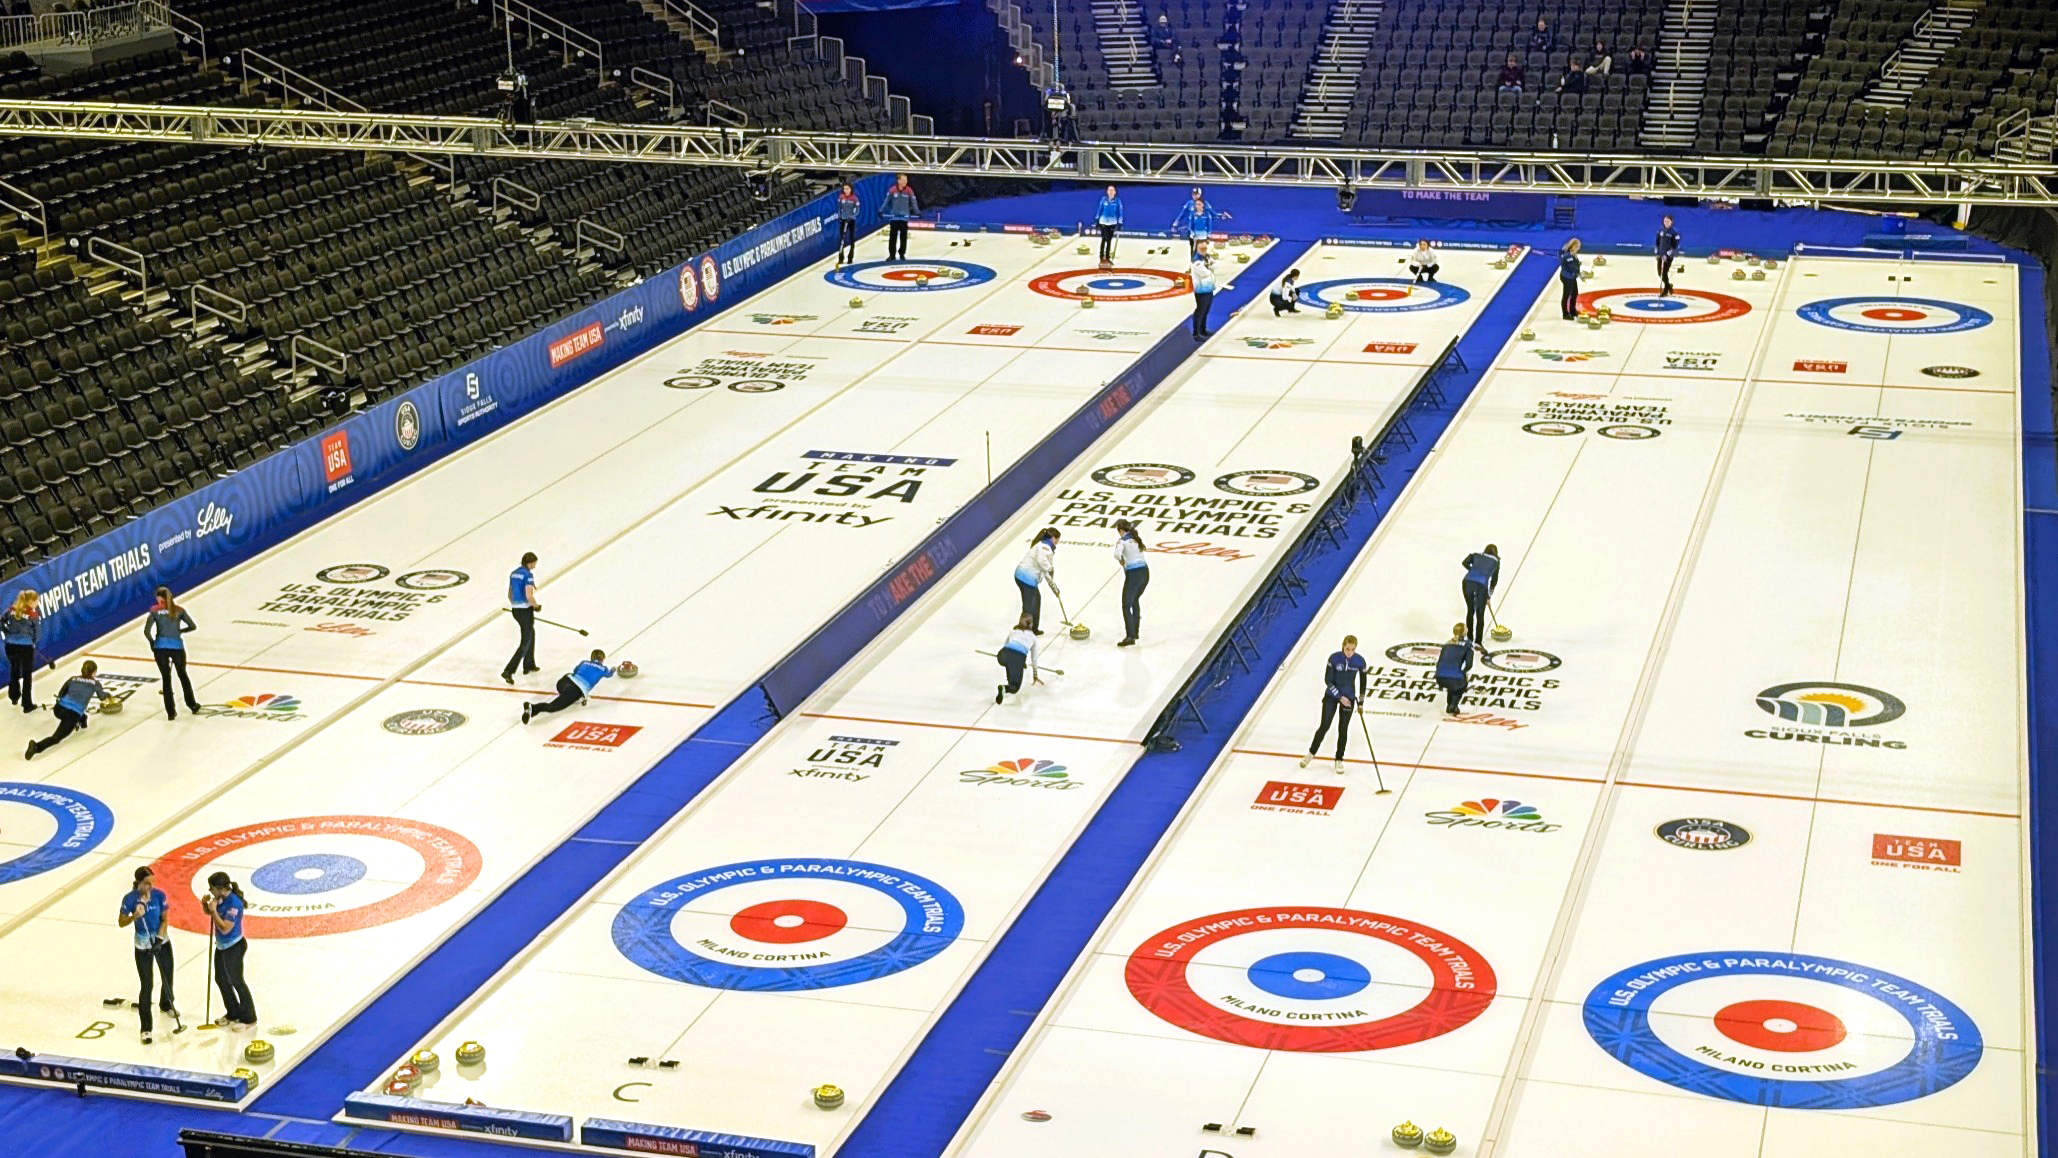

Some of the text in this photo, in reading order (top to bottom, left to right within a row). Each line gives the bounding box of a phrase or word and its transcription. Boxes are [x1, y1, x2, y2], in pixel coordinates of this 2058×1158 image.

[1402, 190, 1490, 201] TO MAKE THE TEAM
[734, 249, 755, 275] OLYMPIC
[760, 231, 792, 259] PARALYMPIC
[792, 224, 805, 245] TEAM
[805, 216, 822, 240] TRIALS
[618, 305, 644, 331] xfinity
[551, 339, 574, 364] MAKING
[573, 331, 590, 353] TEAM
[589, 326, 602, 346] USA
[695, 364, 806, 375] PARALYMPIC
[701, 358, 764, 367] TRIALS
[695, 369, 769, 379] OLYMPIC
[400, 405, 411, 415] USA
[457, 402, 498, 427] SPORTS AUTHORITY
[460, 395, 493, 416] SIOUX FALLS
[1538, 401, 1669, 413] TEAM TRIALS
[1538, 407, 1664, 419] PARALYMPIC
[1542, 412, 1629, 424] OLYMPIC
[1639, 416, 1673, 426] U.S.
[327, 440, 343, 452] TEAM
[327, 451, 347, 473] USA
[820, 452, 939, 465] MAKING
[807, 461, 927, 477] TEAM
[328, 475, 354, 494] ONE FOR ALL
[752, 472, 923, 504] USA
[762, 498, 848, 507] presented
[1056, 489, 1312, 514] U.S. OLYMPIC &
[706, 505, 895, 528] xfinity
[1062, 502, 1284, 526] PARALYMPIC
[1154, 520, 1280, 539] TRIALS
[75, 501, 234, 599] TEAM TRIALS presented by Lilly
[1143, 541, 1255, 562] Lilly
[275, 593, 421, 612] PARALYMPIC
[280, 583, 448, 604] U.S. OLYMPIC &
[258, 602, 410, 622] TEAM TRIALS
[1367, 666, 1560, 689] U.S. &
[1365, 688, 1542, 711] TEAM RIALS
[197, 703, 307, 722] Sports
[422, 708, 453, 717] USA
[1442, 712, 1529, 731] Lilly
[386, 722, 448, 735] CURLING
[566, 729, 620, 743] USA
[580, 725, 621, 734] TEAM
[1771, 726, 1882, 739] SIOUX FALLS
[830, 742, 886, 752] TEAM
[1744, 729, 1907, 750] CURLING
[807, 749, 884, 768] USA
[787, 768, 870, 782] xfinity
[959, 770, 1084, 791] Sports
[1269, 790, 1325, 806] USA
[1282, 785, 1323, 795] TEAM
[0, 787, 95, 848] RALYMPIC TEAM TRIALS
[1424, 811, 1562, 833] Sports
[1686, 818, 1724, 828] USA
[1664, 834, 1740, 850] CURLING
[1894, 838, 1938, 848] TEAM
[181, 820, 464, 885] U.S. OLYMPIC & PARALYMPIC TEAM TRIALS
[1885, 845, 1947, 861] USA
[1871, 860, 1898, 868] ONE
[1903, 863, 1930, 871] FOR
[259, 902, 336, 912] CORTINA
[649, 864, 945, 933] U.S. OLYMPIC & PARALYMPIC TEAM TRIALS
[697, 938, 831, 961] MILANO CORTINA
[1154, 913, 1475, 990] U.S. OLYMPIC & PARALYMPIC TEAM TRIALS
[1220, 994, 1369, 1021] MILANO CORTINA
[1608, 958, 1958, 1041] U.S. OLYMPIC & PARALYMPIC TEAM TRIALS
[75, 1020, 115, 1040] B
[1695, 1045, 1858, 1074] MILANO CORTINA
[109, 1077, 145, 1089] PARALYMPIC
[145, 1081, 160, 1091] TEAM
[161, 1083, 181, 1094] TRIALS
[612, 1081, 653, 1103] C
[391, 1114, 420, 1125] MAKING
[420, 1116, 440, 1128] TEAM
[441, 1119, 457, 1130] USA
[484, 1124, 519, 1138] xfinity
[627, 1137, 657, 1150] MAKING
[658, 1140, 678, 1153] TEAM
[680, 1143, 696, 1155] USA
